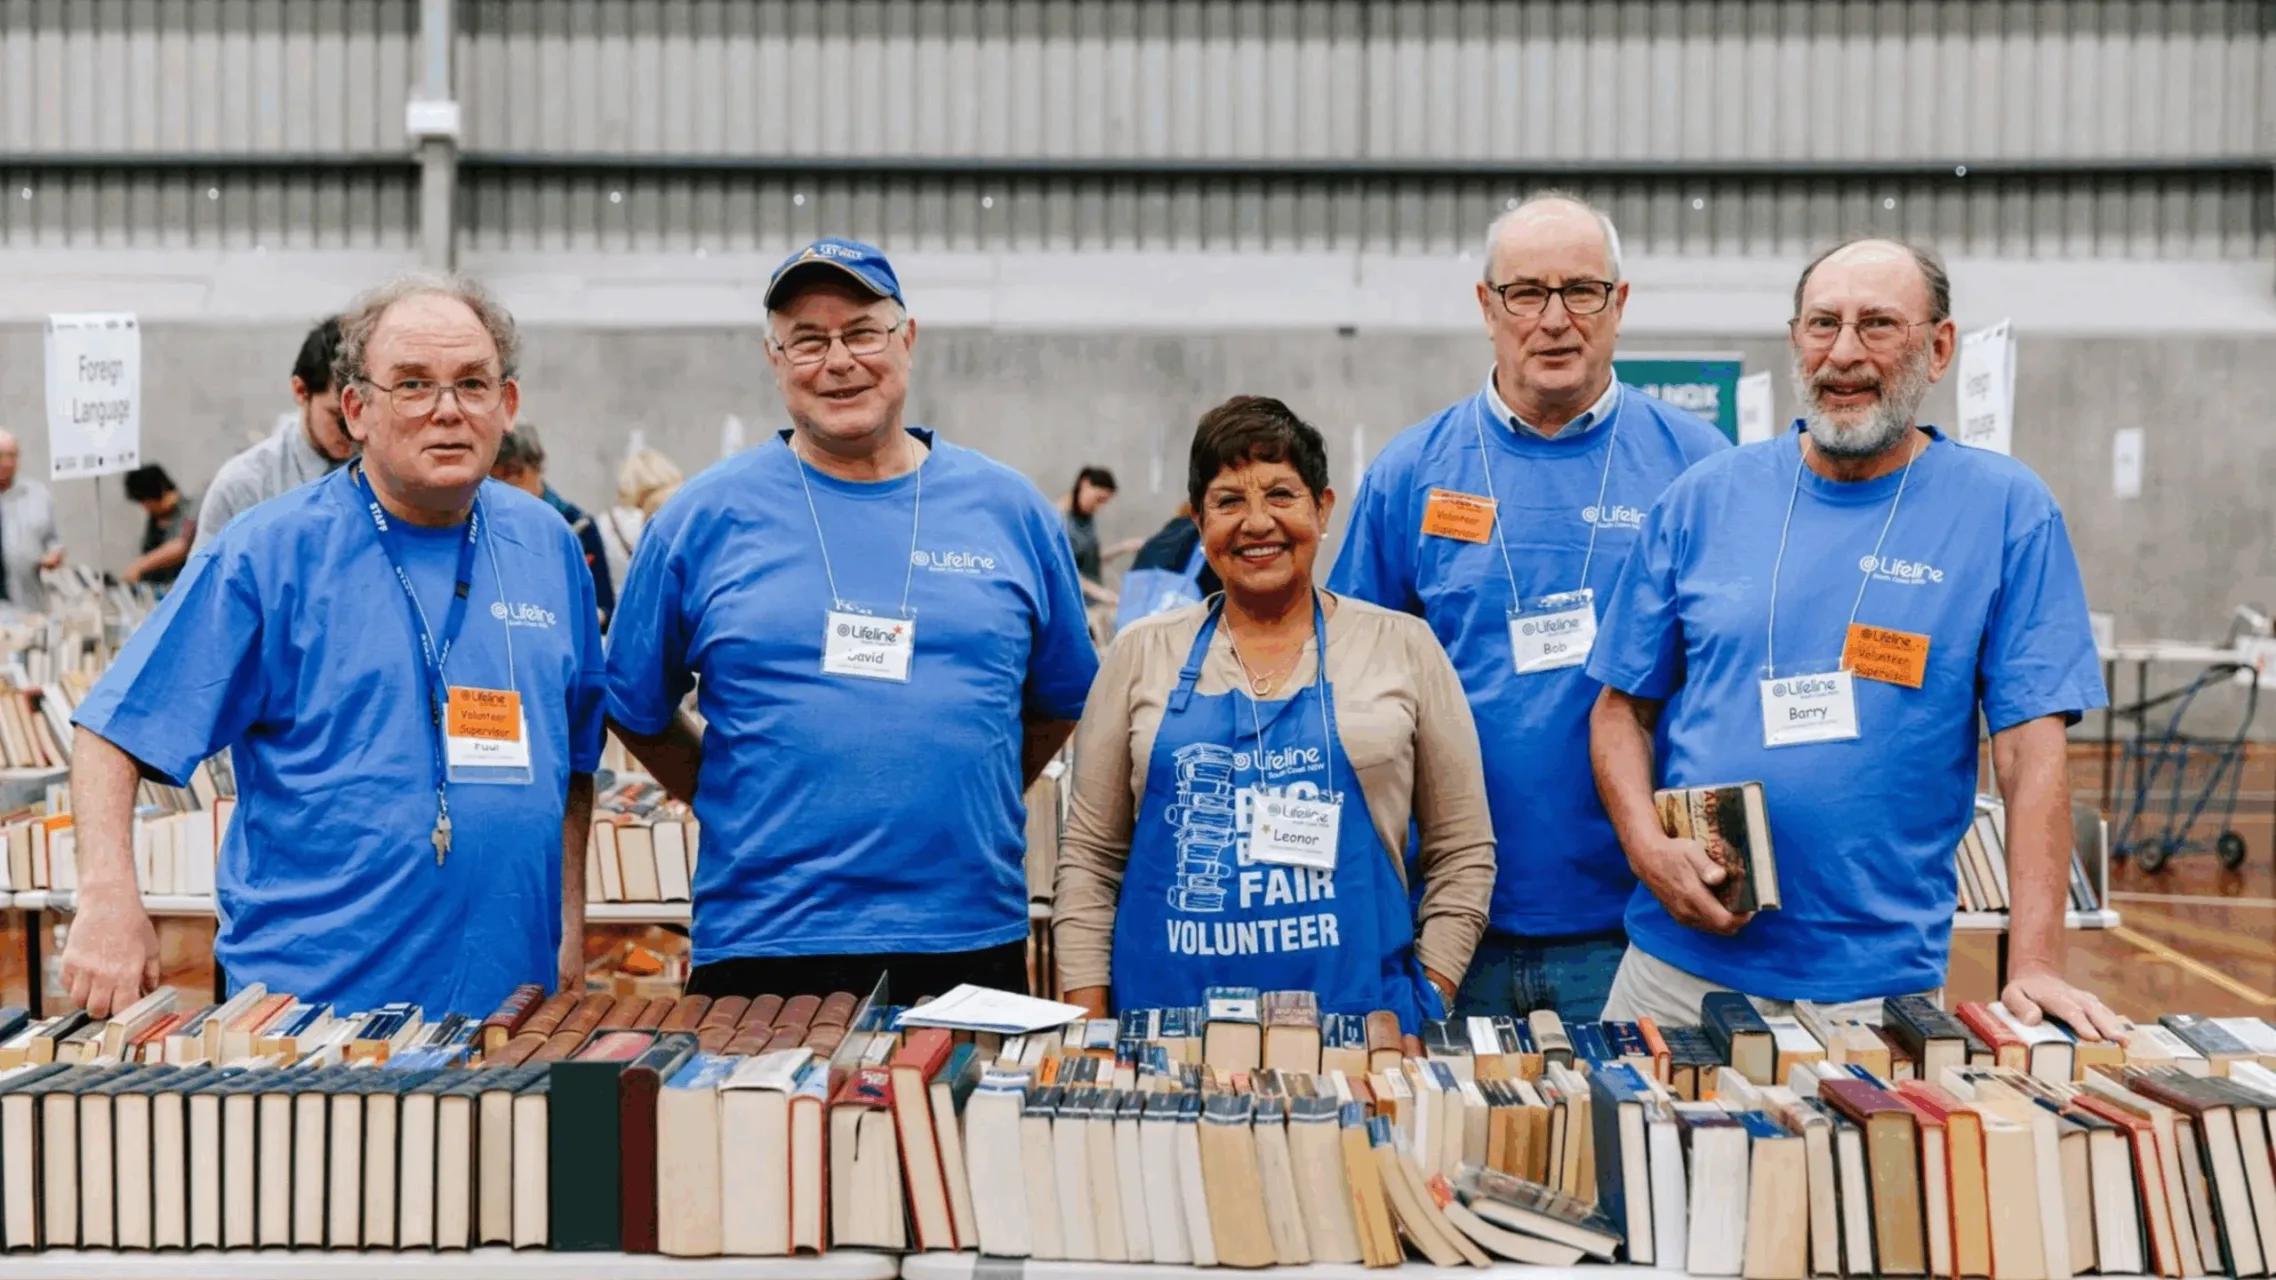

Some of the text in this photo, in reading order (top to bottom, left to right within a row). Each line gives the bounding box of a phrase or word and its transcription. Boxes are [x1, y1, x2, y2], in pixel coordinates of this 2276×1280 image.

[78, 354, 123, 386] Foreign
[72, 397, 130, 427] Language
[369, 502, 388, 532] STAFF
[1602, 505, 1647, 523] Lifelin
[931, 551, 995, 569] Lifeline
[1881, 556, 1944, 582] Lifeline
[508, 602, 556, 625] Lifeline
[851, 625, 897, 642] Lifeline
[1536, 619, 1579, 634] Lifeline
[1543, 642, 1567, 655] Bob
[1787, 679, 1836, 696] Lifeline
[472, 691, 505, 704] Lifeline
[461, 710, 506, 722] Volunteer
[1789, 707, 1828, 720] Barry
[460, 724, 510, 737] Supervisor
[1253, 747, 1320, 770] Lifeline
[1282, 804, 1329, 823] Lifeline
[1273, 828, 1320, 845] Leonor
[1239, 865, 1336, 909] FAIR
[1166, 912, 1340, 957] VOLUNTEER
